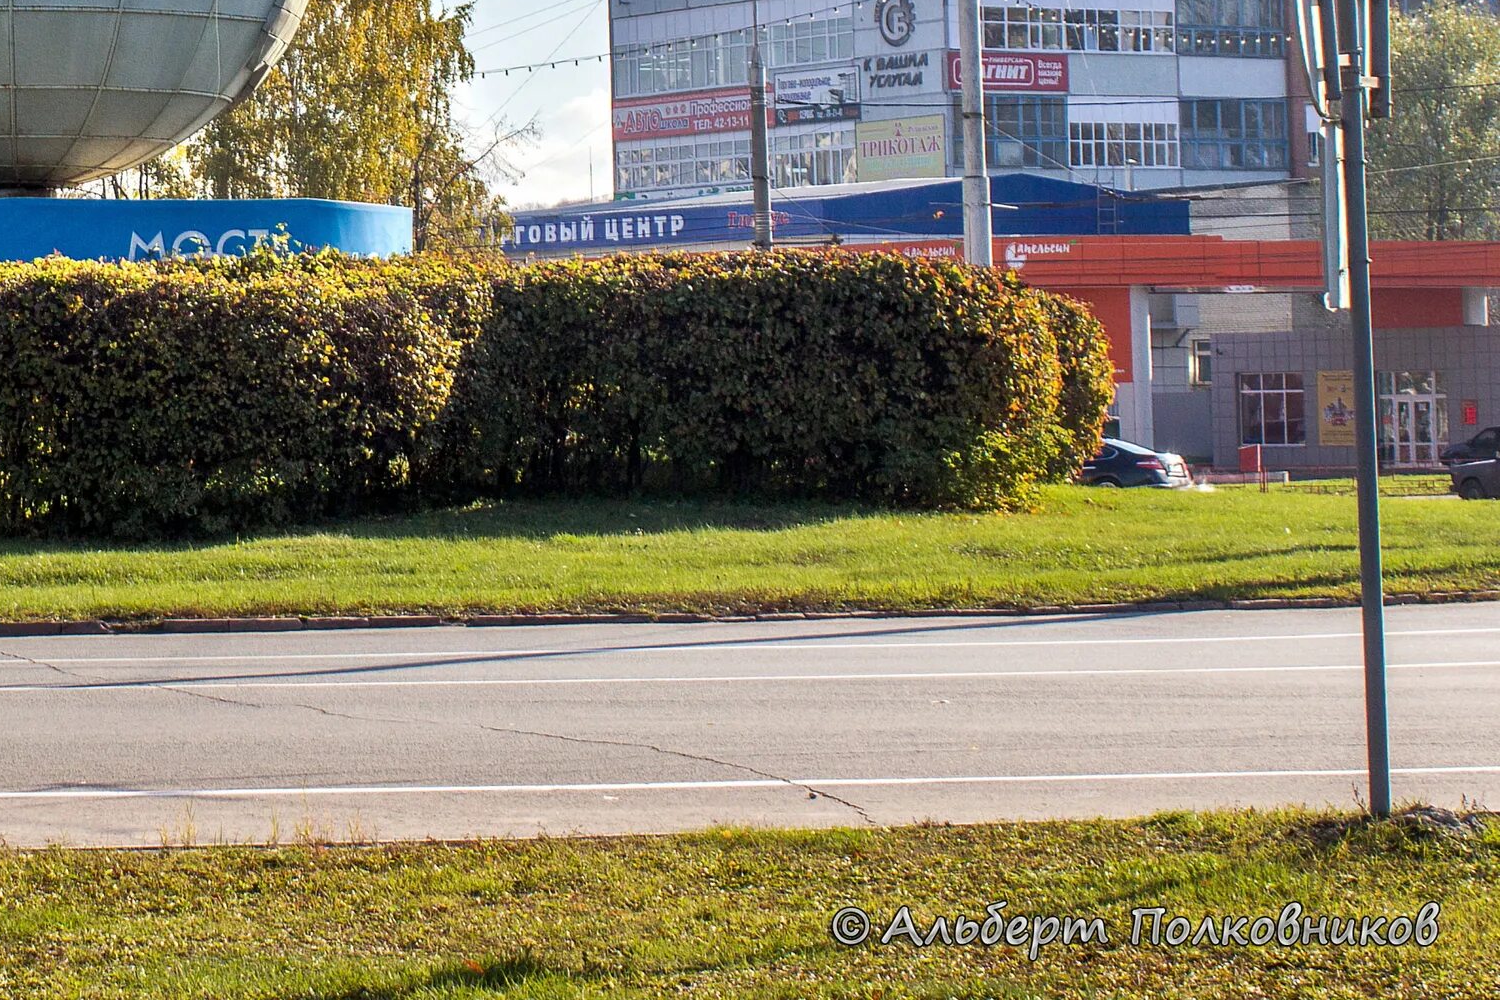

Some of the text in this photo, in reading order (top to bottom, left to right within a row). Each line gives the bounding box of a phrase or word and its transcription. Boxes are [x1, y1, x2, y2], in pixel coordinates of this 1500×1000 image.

[876, 53, 928, 71] ВАШИМ
[869, 72, 923, 88] УСЛУГАМ
[714, 115, 750, 128] 42-13-11
[860, 135, 941, 157] ТРИКОТАЖ
[605, 215, 685, 241] ЦЕНТР
